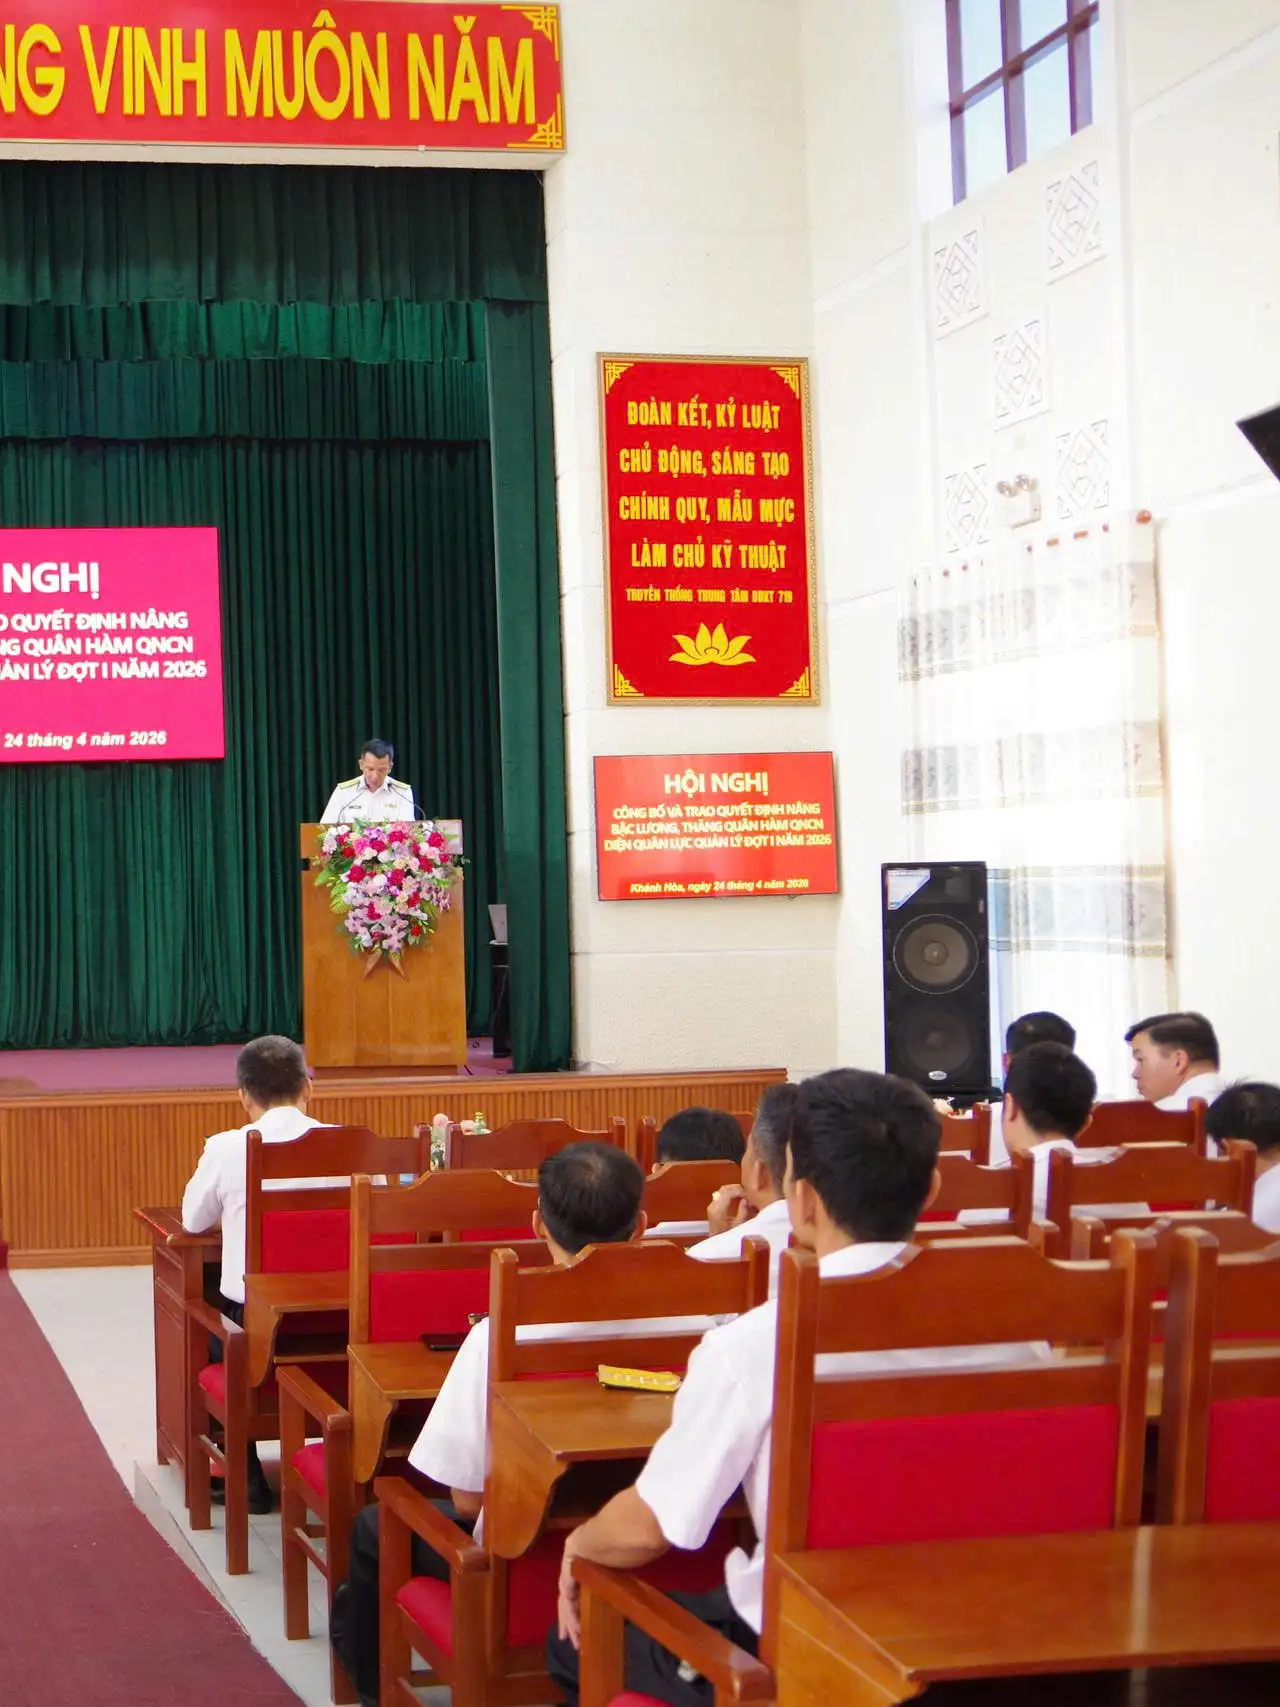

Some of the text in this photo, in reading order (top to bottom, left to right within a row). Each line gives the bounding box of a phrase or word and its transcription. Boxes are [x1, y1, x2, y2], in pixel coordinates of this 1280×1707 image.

[79, 25, 206, 118] VINH
[225, 9, 389, 120] MUÔN
[408, 15, 536, 124] NĂM
[627, 394, 780, 432] ĐOÀN KẾT, KỶ LUẬT
[619, 440, 790, 480] CHỦ ĐỘNG, SÁNG TẠO
[619, 488, 795, 527] CHÍNH QUY, MẪU MỰC
[631, 536, 787, 572] LÀM CHỦ KỸ THUẬT
[2, 562, 100, 600] NGHỊ
[10, 608, 74, 632] QUYẾT
[75, 612, 127, 634] ĐỊNH
[130, 608, 188, 630] NÂNG
[22, 633, 82, 658] QUÂN
[85, 633, 133, 655] HÀM
[135, 636, 194, 655] QNCN
[33, 658, 54, 680] LÝ
[56, 660, 99, 684] ĐỢT
[102, 662, 108, 680] I
[112, 657, 160, 678] NĂM
[162, 660, 208, 678] 2026
[4, 733, 23, 748] 24
[27, 732, 72, 750] tháng
[76, 732, 87, 746] 4
[90, 732, 125, 747] năm
[130, 730, 168, 746] 2026
[664, 769, 768, 798] HỘI NGHỊ
